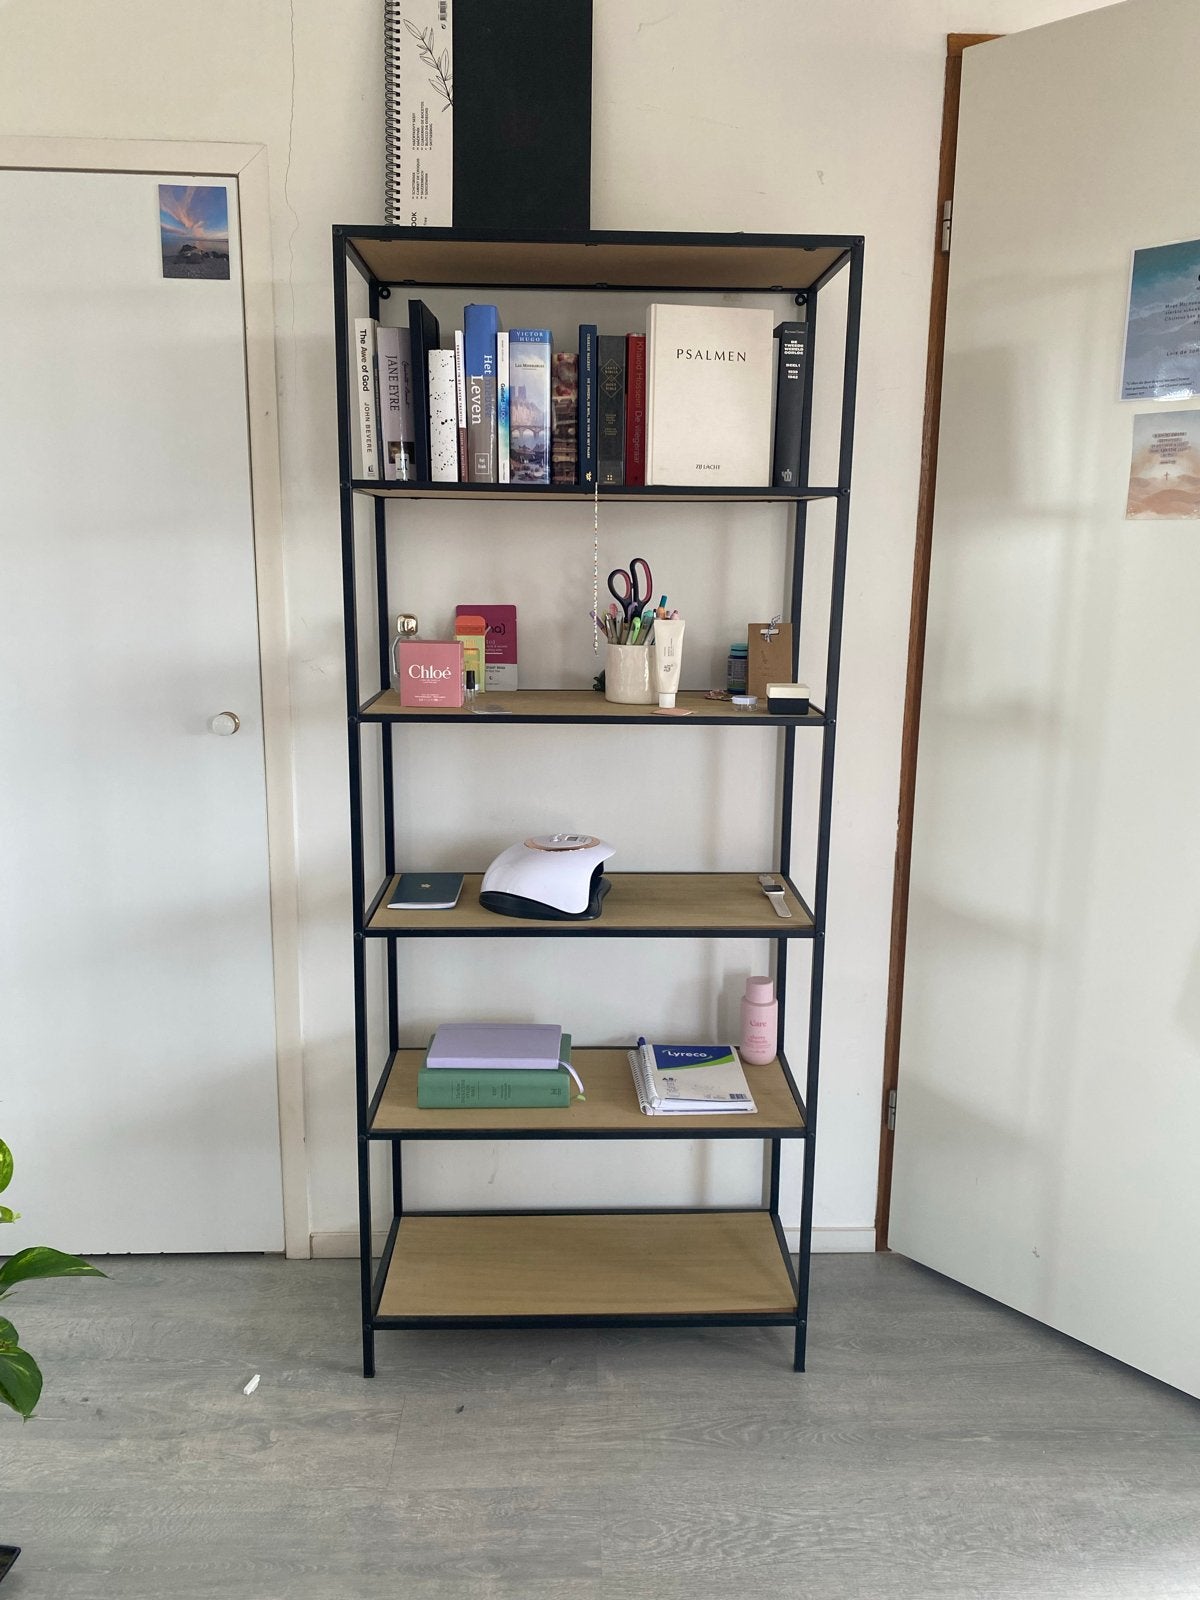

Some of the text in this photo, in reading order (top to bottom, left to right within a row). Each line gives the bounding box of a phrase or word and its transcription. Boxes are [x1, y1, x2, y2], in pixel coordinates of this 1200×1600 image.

[676, 349, 747, 362] PSALMEN
[484, 355, 492, 374] Het
[386, 355, 399, 411] JANE EYRE
[471, 375, 483, 425] Leven
[634, 410, 641, 422] De
[408, 664, 452, 679] Chloé
[667, 1050, 707, 1058] Lyreco
